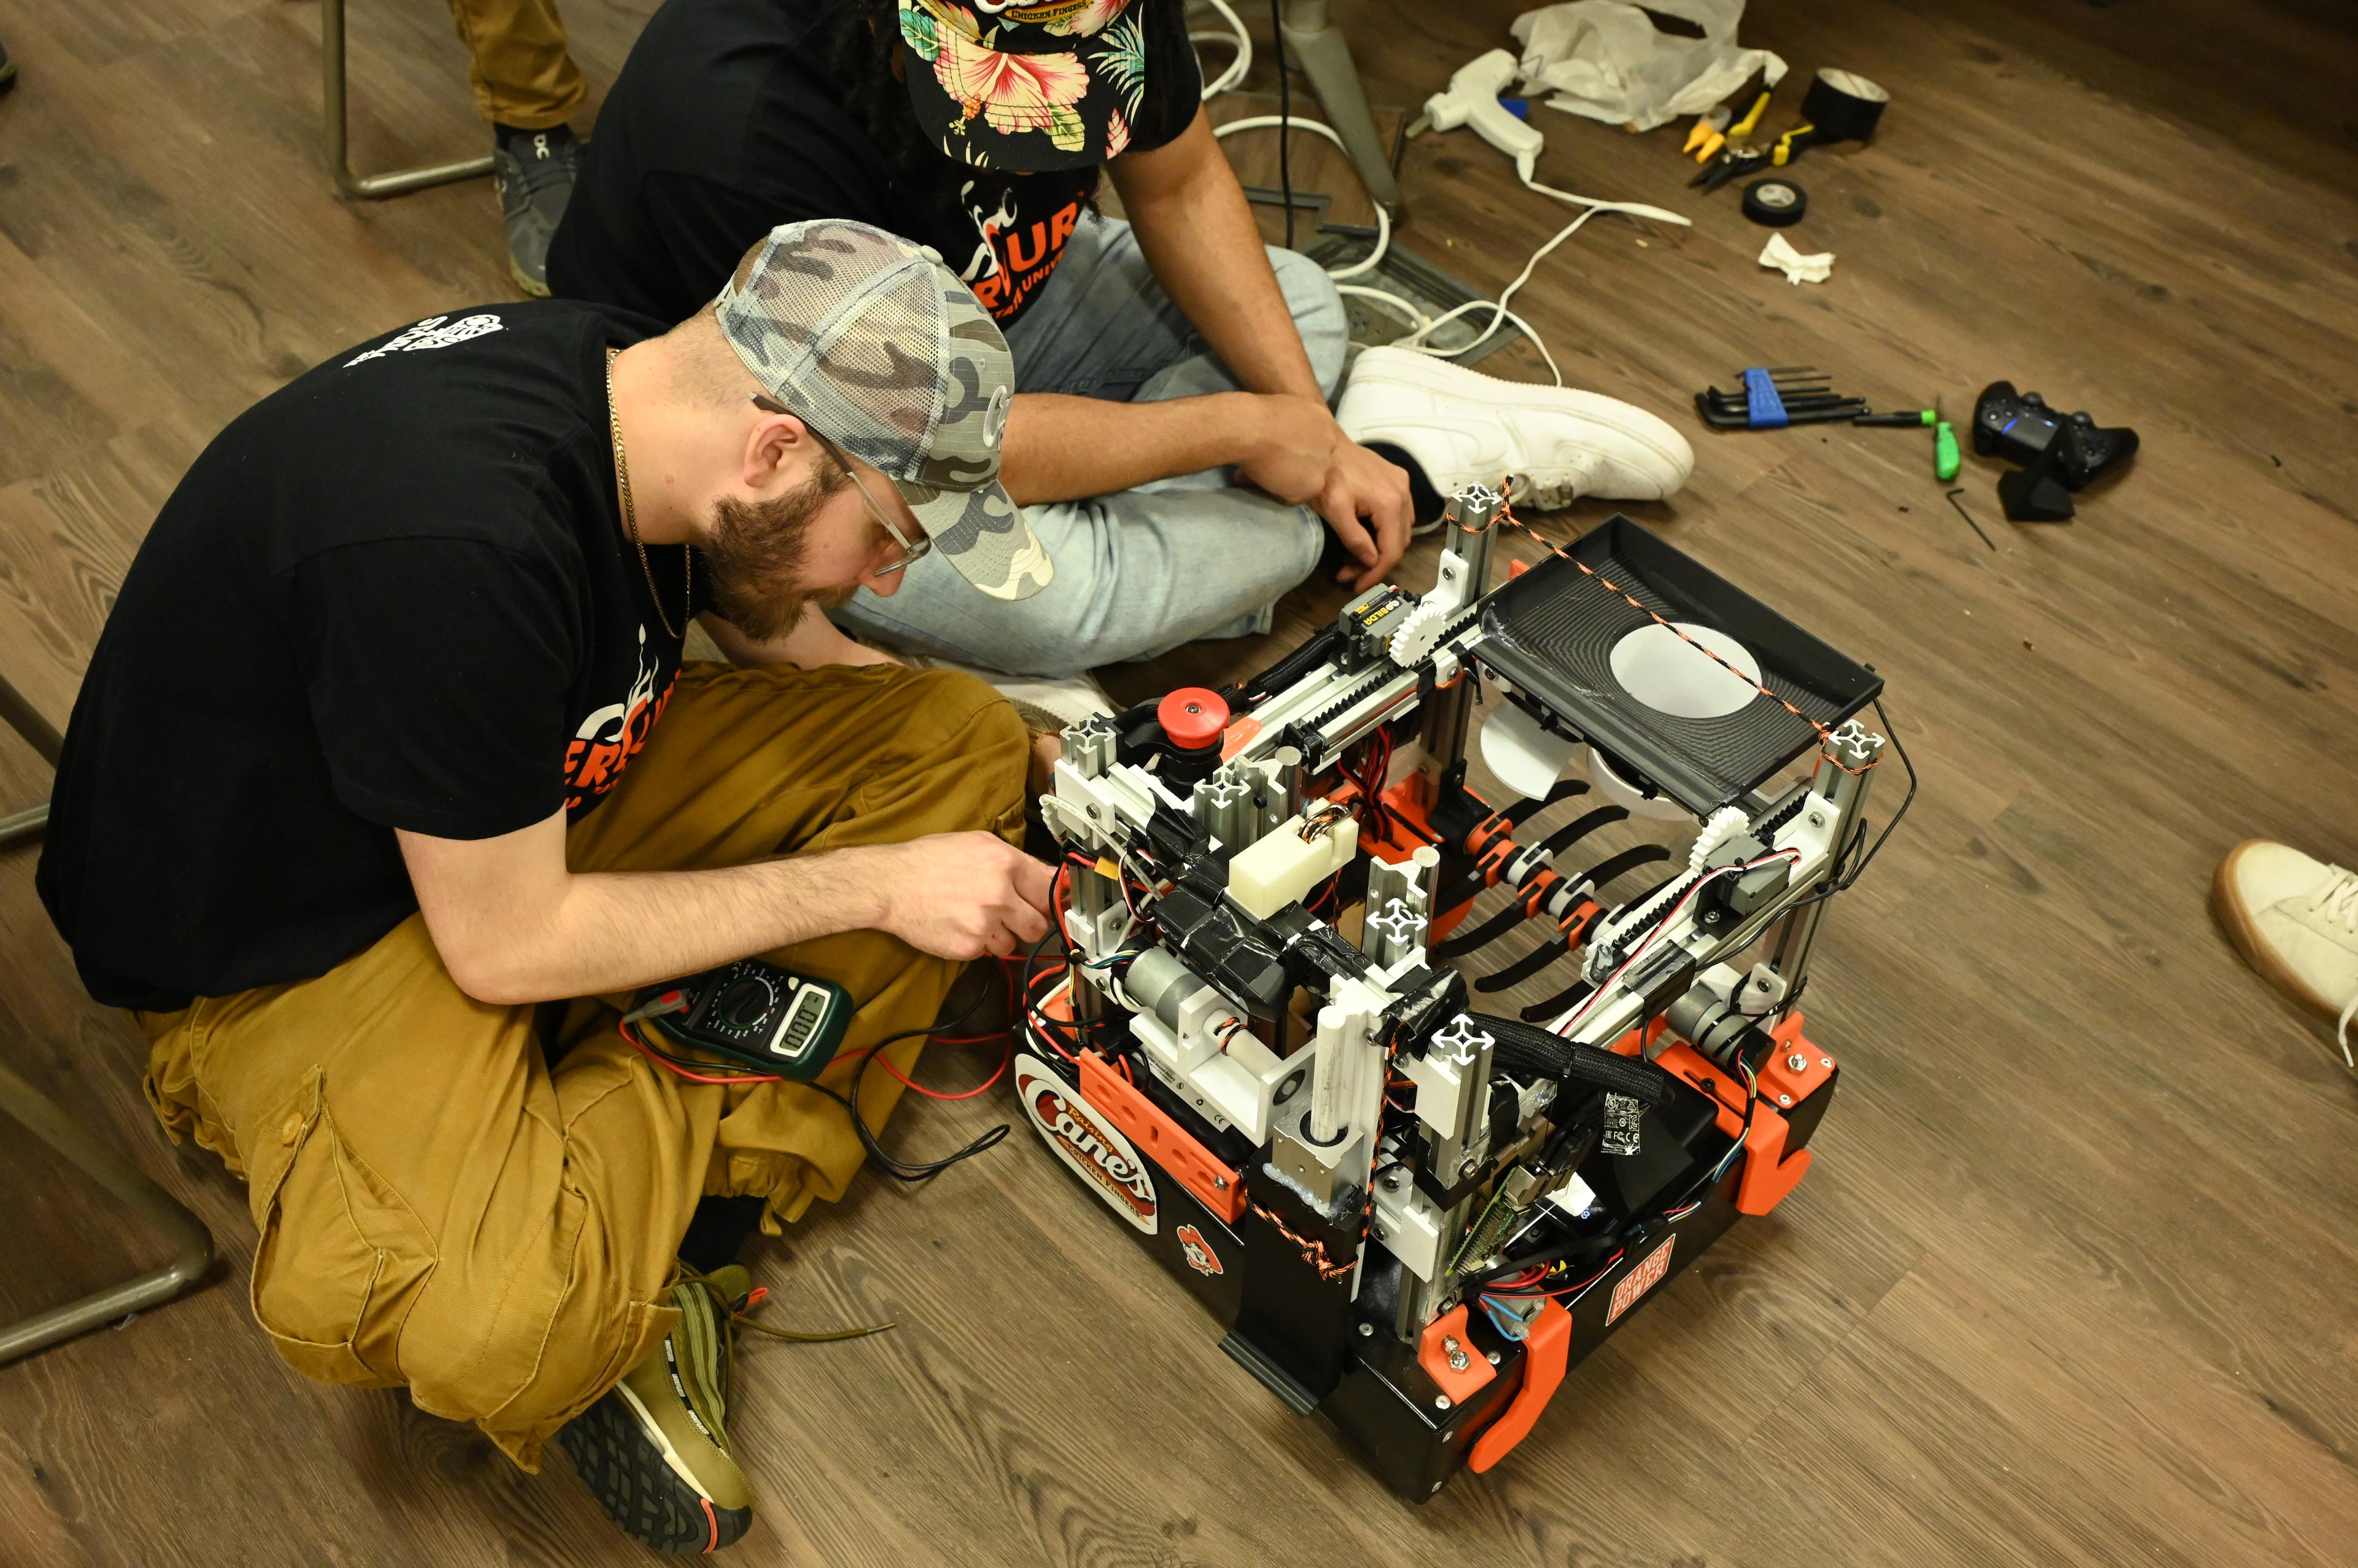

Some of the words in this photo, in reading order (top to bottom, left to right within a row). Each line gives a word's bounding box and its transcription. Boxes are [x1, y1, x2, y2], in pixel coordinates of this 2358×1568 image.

[1011, 9, 1051, 20] CHICKEN
[1053, 1, 1086, 16] FINGERS
[1024, 1079, 1154, 1202] Cane's
[1068, 1105, 1113, 1153] Raising
[1068, 1143, 1103, 1183] CHICKEN
[1105, 1180, 1142, 1219] FINGERS
[1611, 1260, 1665, 1319] POWER
[1616, 1240, 1671, 1301] ORANGE
